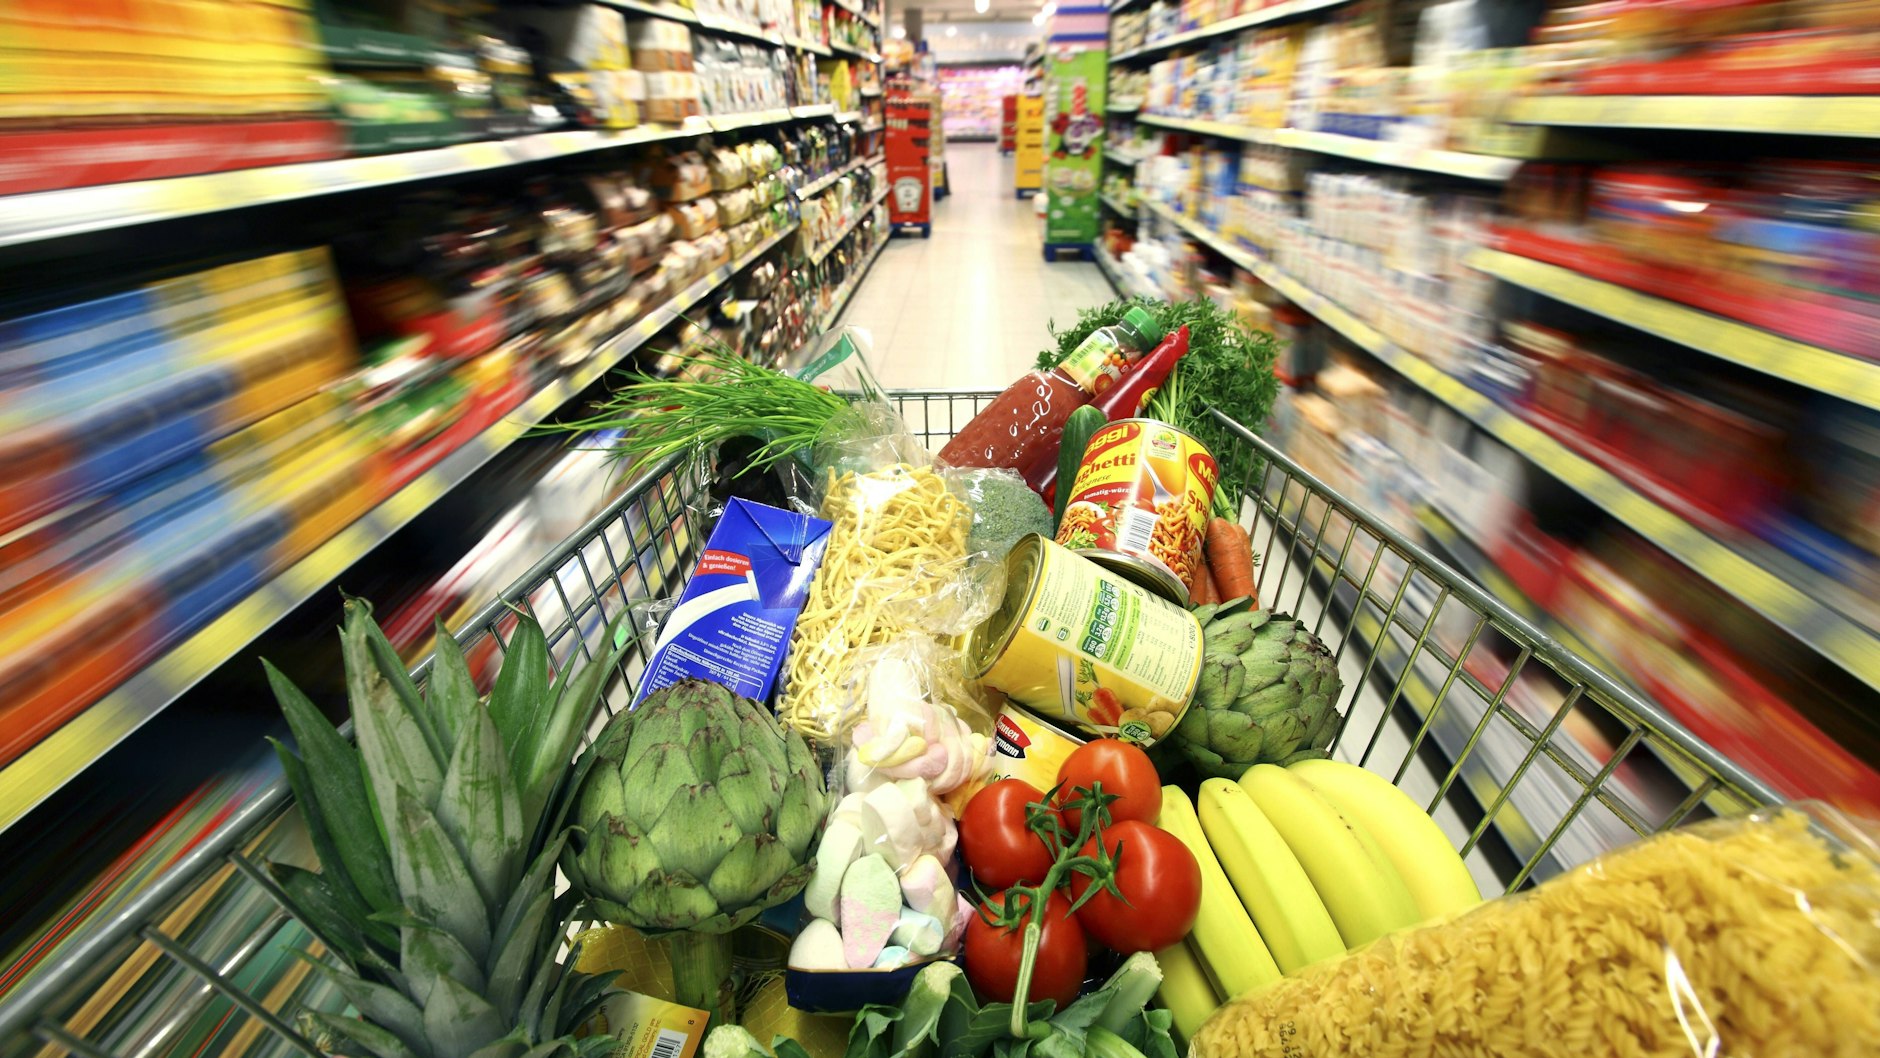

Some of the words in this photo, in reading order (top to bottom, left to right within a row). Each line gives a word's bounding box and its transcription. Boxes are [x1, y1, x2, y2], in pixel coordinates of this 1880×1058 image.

[1083, 425, 1128, 458] aggi
[709, 563, 736, 571] genießen!
[725, 556, 750, 566] dosieren
[1088, 640, 1097, 652] 360
[642, 1026, 652, 1043] GOLD
